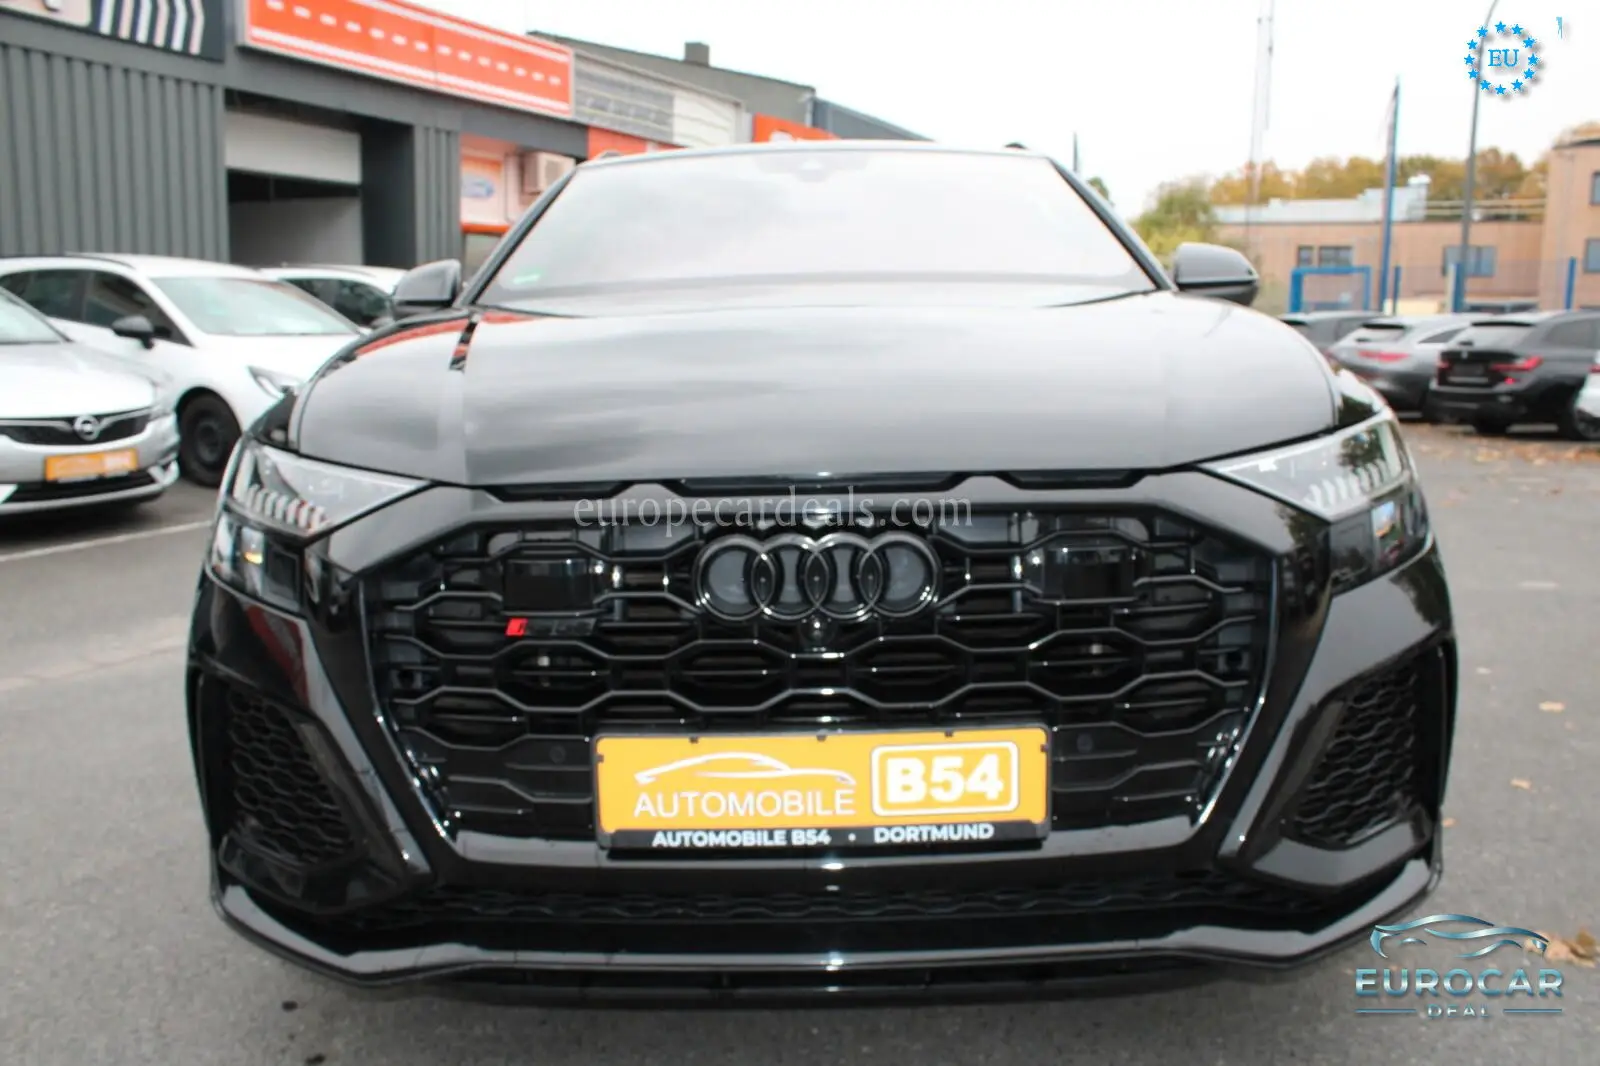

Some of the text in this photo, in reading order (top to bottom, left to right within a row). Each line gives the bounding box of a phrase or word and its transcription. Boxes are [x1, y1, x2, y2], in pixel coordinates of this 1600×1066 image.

[634, 755, 1003, 818] AUTOMOBILE B54
[652, 822, 995, 848] AUTOMOBILE B54 DORTMUND
